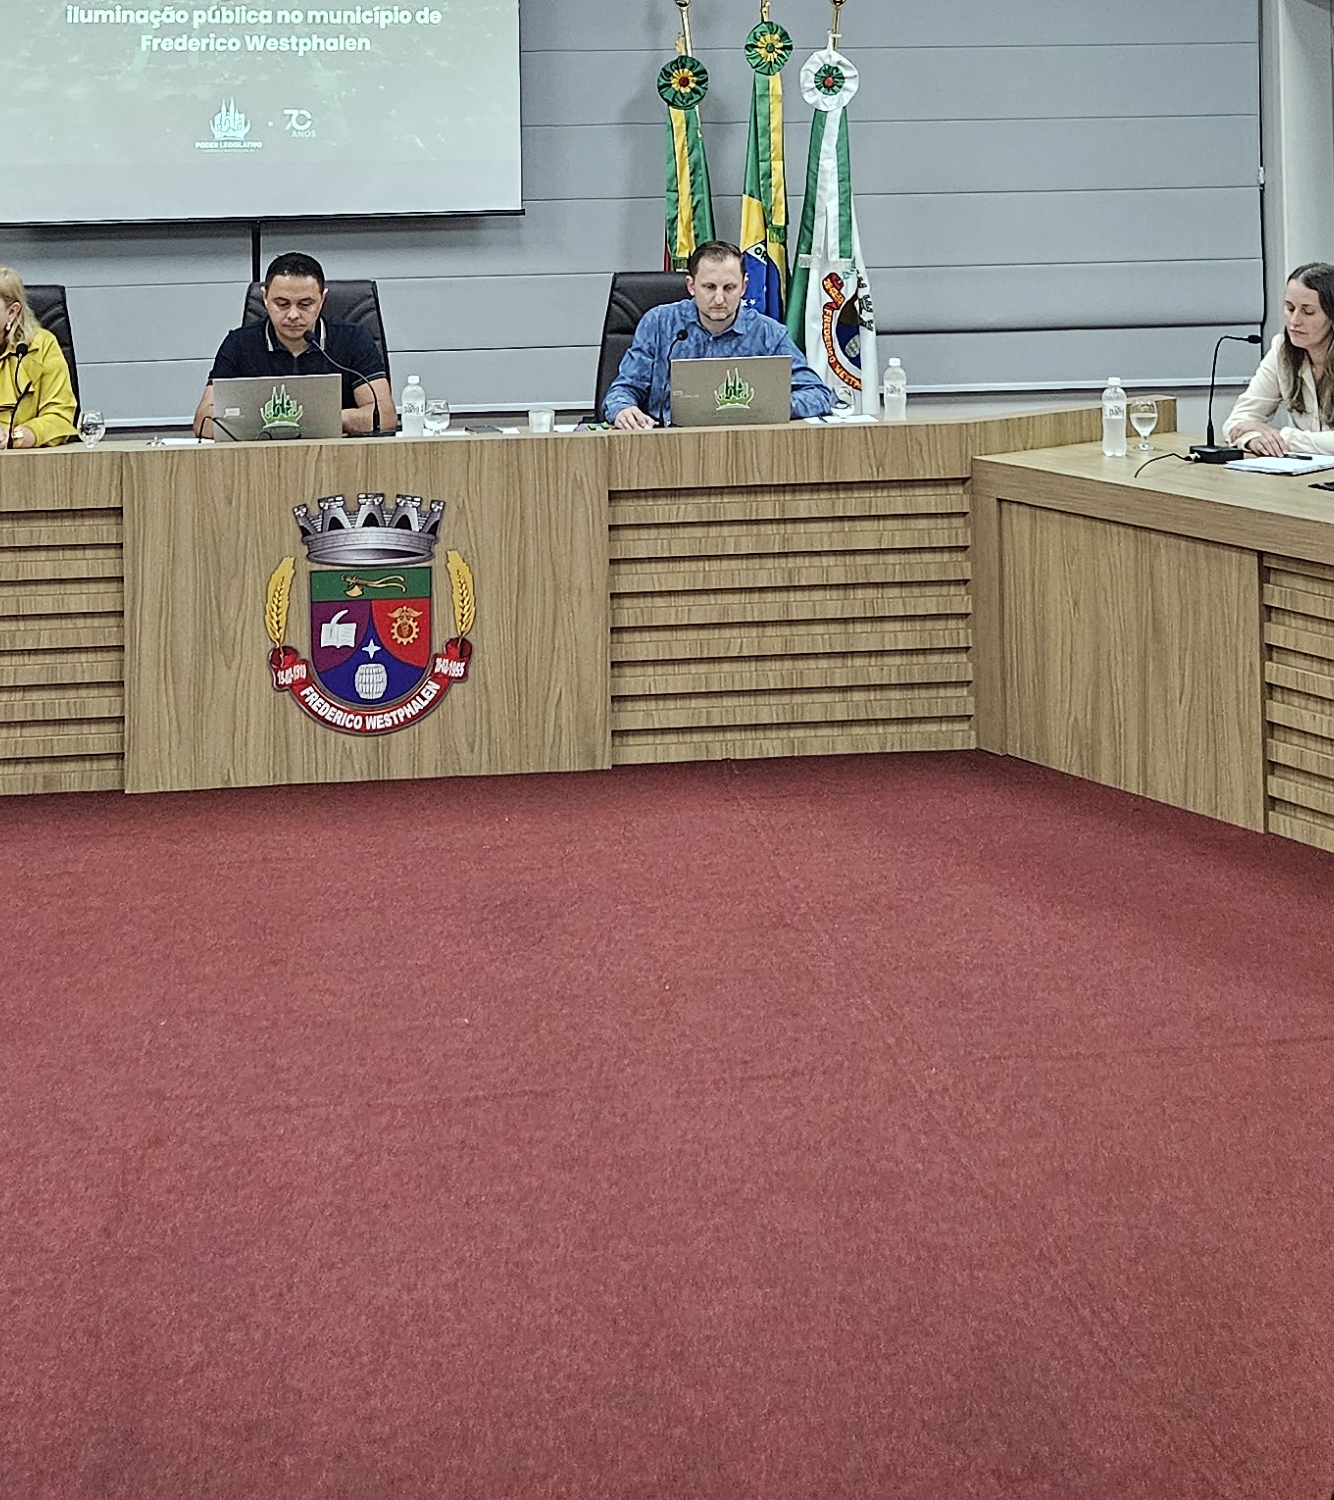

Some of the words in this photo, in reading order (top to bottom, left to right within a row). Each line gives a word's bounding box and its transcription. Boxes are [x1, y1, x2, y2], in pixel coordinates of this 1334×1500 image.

[66, 5, 190, 29] iluminação
[192, 5, 273, 30] pública
[276, 10, 303, 24] no
[306, 5, 412, 29] município
[415, 6, 442, 24] de
[141, 33, 241, 52] Frederico
[244, 34, 371, 56] Westphalen
[283, 108, 313, 131] 70
[195, 141, 219, 149] PODER
[219, 141, 263, 149] LEGISLATIVO
[291, 129, 316, 138] ANOS
[299, 685, 363, 730] FREDERICO
[364, 679, 441, 730] WESTPHALEN
